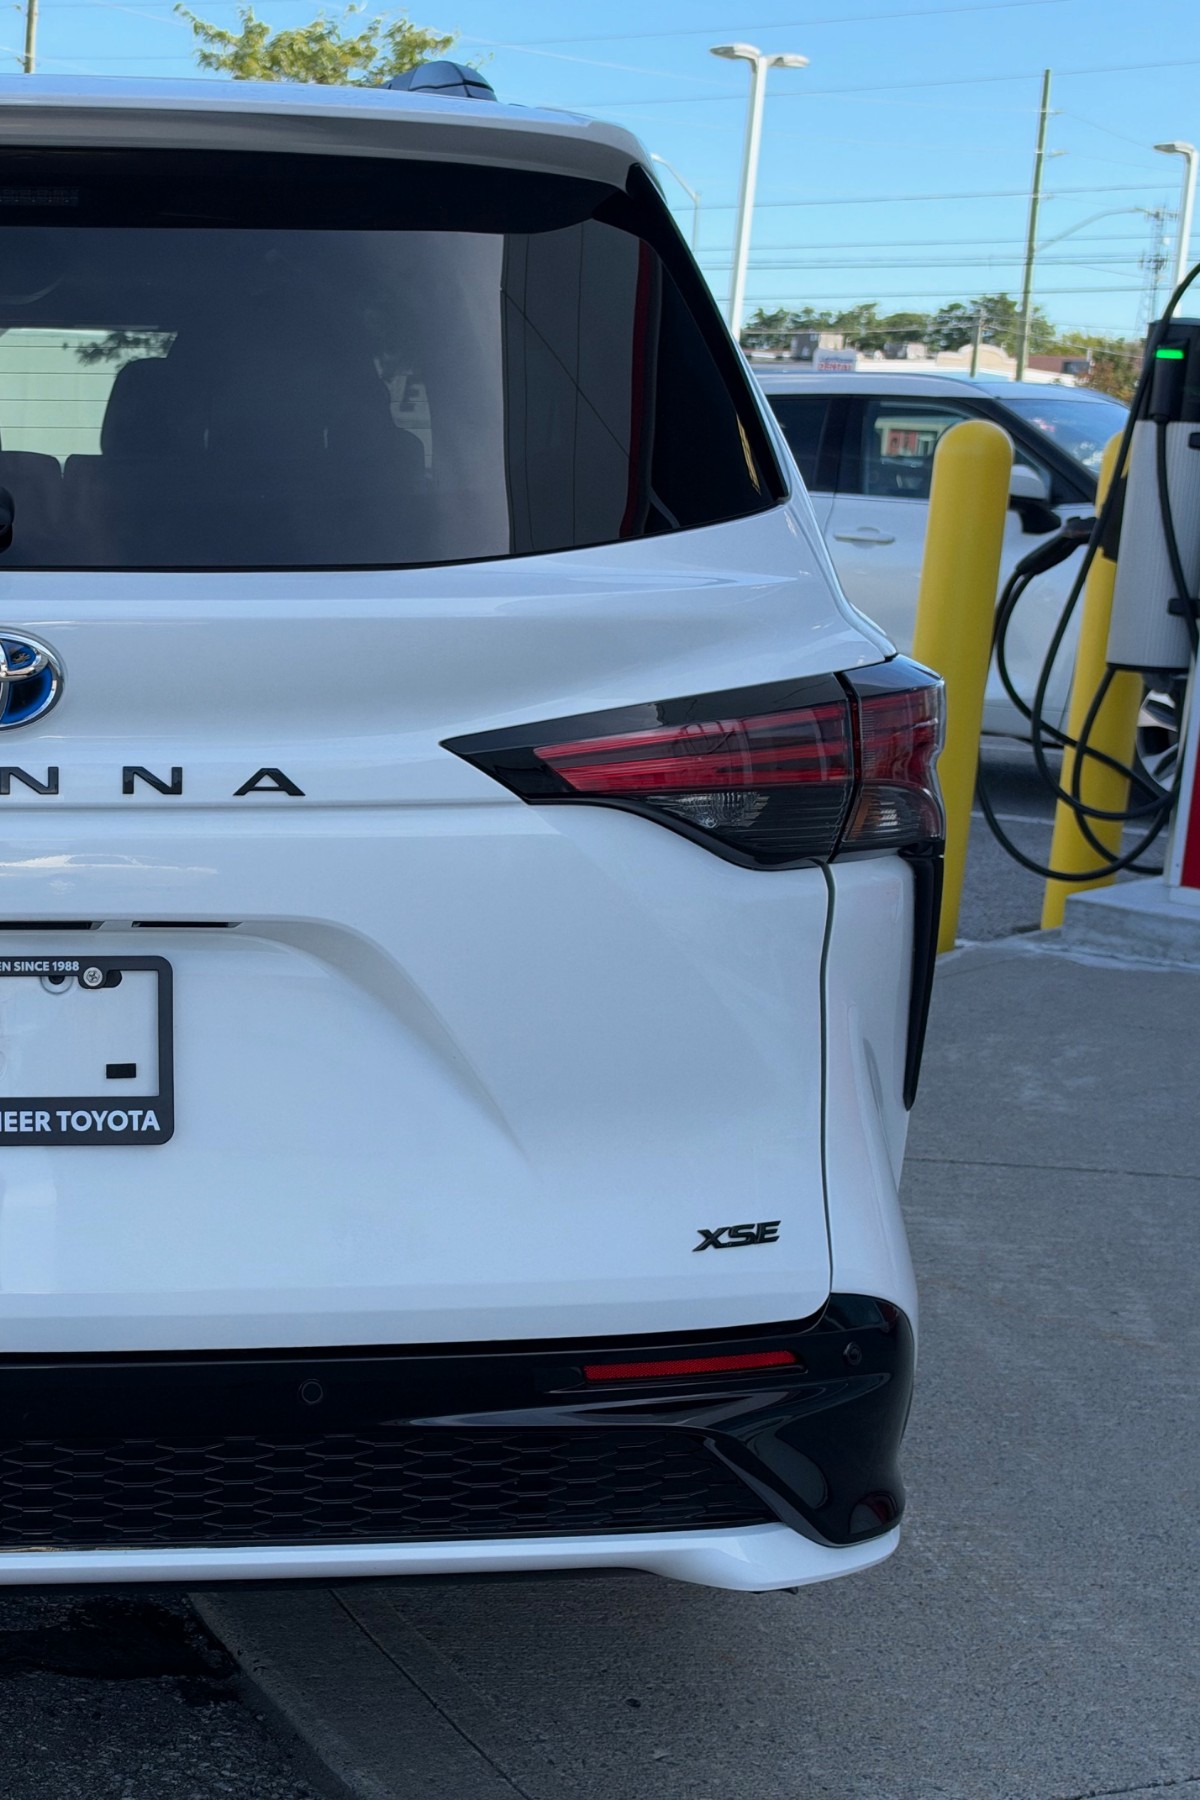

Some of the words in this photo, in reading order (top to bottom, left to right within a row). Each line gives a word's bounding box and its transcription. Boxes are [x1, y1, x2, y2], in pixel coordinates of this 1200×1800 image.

[13, 961, 50, 971] SINCE
[52, 961, 80, 971] 1988
[56, 1110, 161, 1132] TOYOTA
[692, 1220, 781, 1252] XSE
